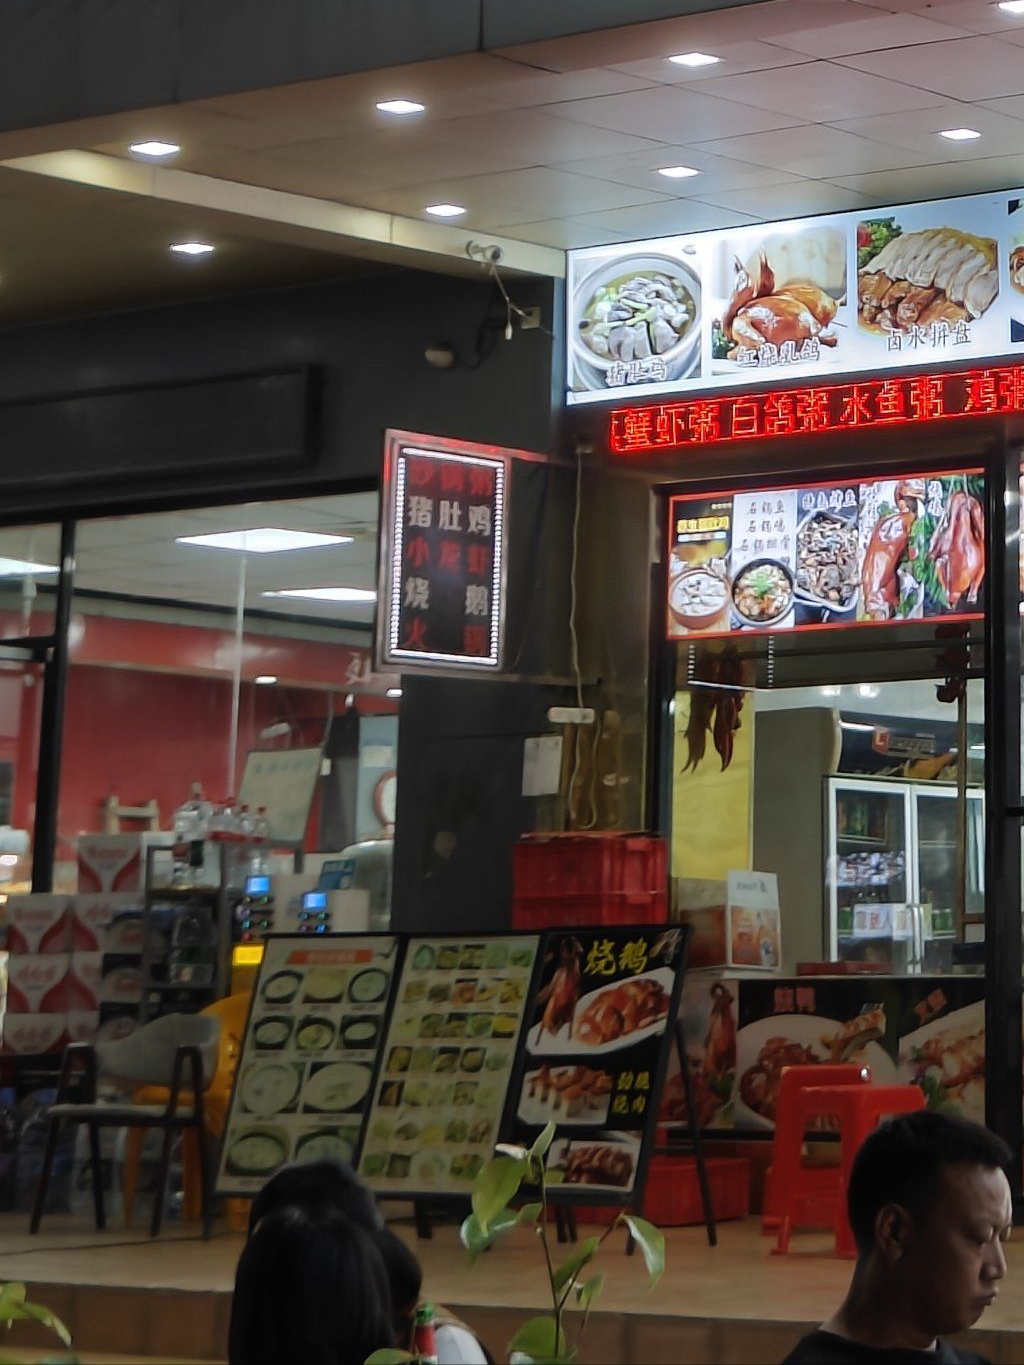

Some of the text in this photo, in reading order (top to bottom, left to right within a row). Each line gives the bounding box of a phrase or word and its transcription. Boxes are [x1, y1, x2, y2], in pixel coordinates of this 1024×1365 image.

[886, 320, 972, 352] 卤水拼盘
[407, 495, 492, 537] 猪肚鸡
[584, 938, 649, 976] 烧鹅
